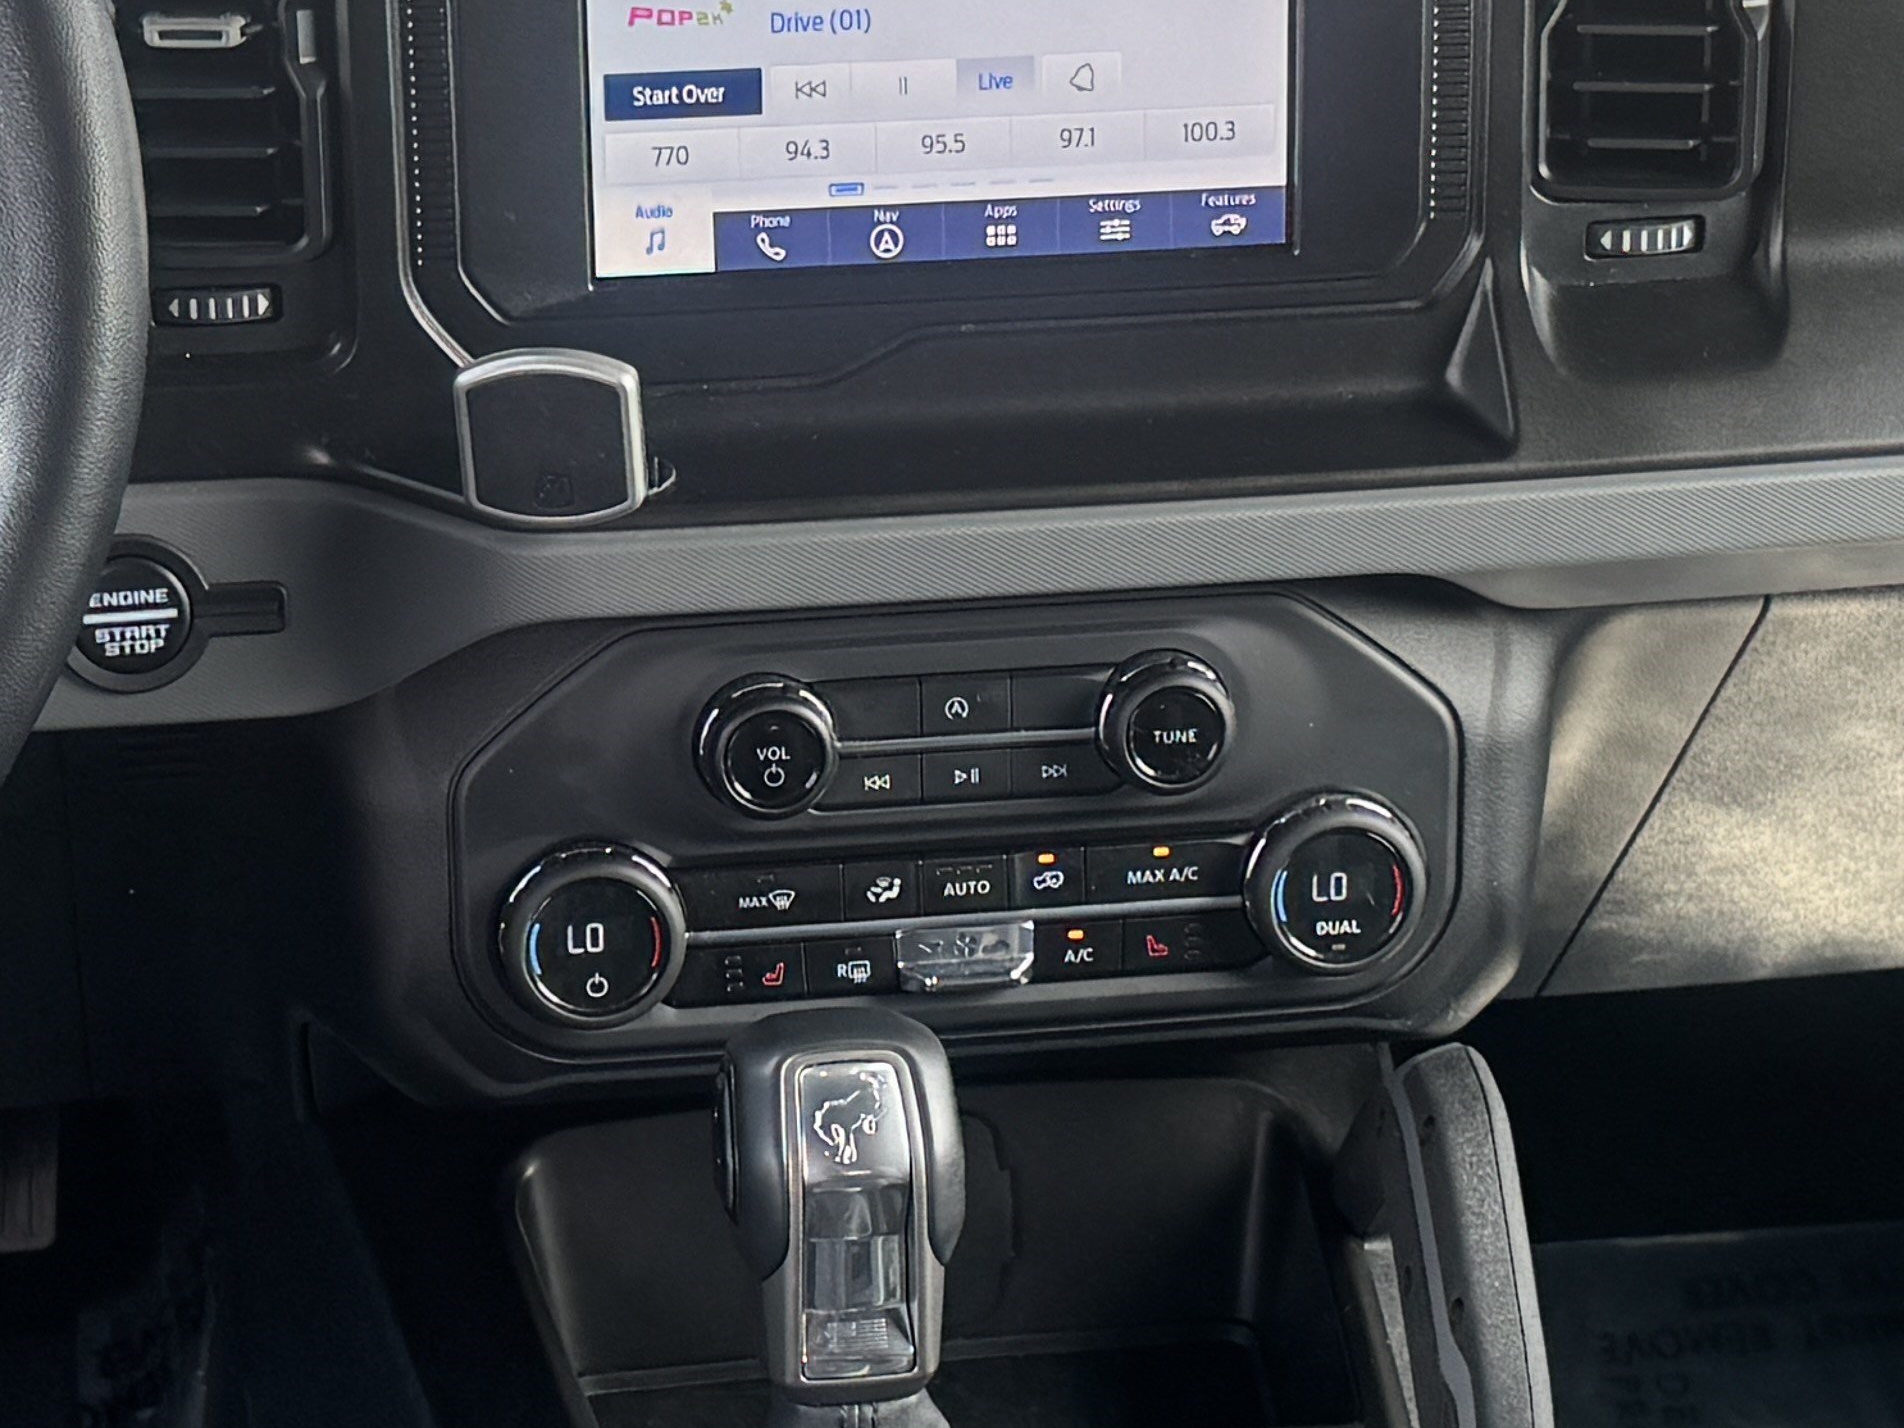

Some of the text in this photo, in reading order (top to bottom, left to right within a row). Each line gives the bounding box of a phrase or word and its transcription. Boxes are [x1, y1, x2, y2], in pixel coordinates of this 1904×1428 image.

[769, 8, 872, 36] Drive (01)
[977, 73, 1014, 91] Live
[632, 84, 726, 107] Start Over
[1059, 126, 1097, 149] 97.1
[1182, 120, 1237, 143] 100.3
[784, 138, 831, 161] 94.3
[920, 133, 967, 155] 95.5
[651, 145, 690, 167] 770
[1087, 197, 1142, 214] Settings
[1200, 191, 1257, 208] Features
[634, 203, 674, 219] Audio
[873, 209, 900, 223] Nav
[983, 203, 1018, 220] Apps
[750, 213, 791, 229] Phone
[88, 587, 169, 608] ENGINE
[94, 624, 170, 643] START
[104, 639, 165, 657] STOP
[1153, 729, 1198, 744] TUNE
[756, 747, 791, 761] VOL
[1126, 865, 1199, 886] MAX A/C
[943, 879, 991, 899] AUTO
[1311, 872, 1348, 903] LO
[738, 896, 769, 909] MAX
[1315, 918, 1361, 937] DUAL
[566, 922, 605, 955] LO
[1063, 946, 1094, 964] A/C
